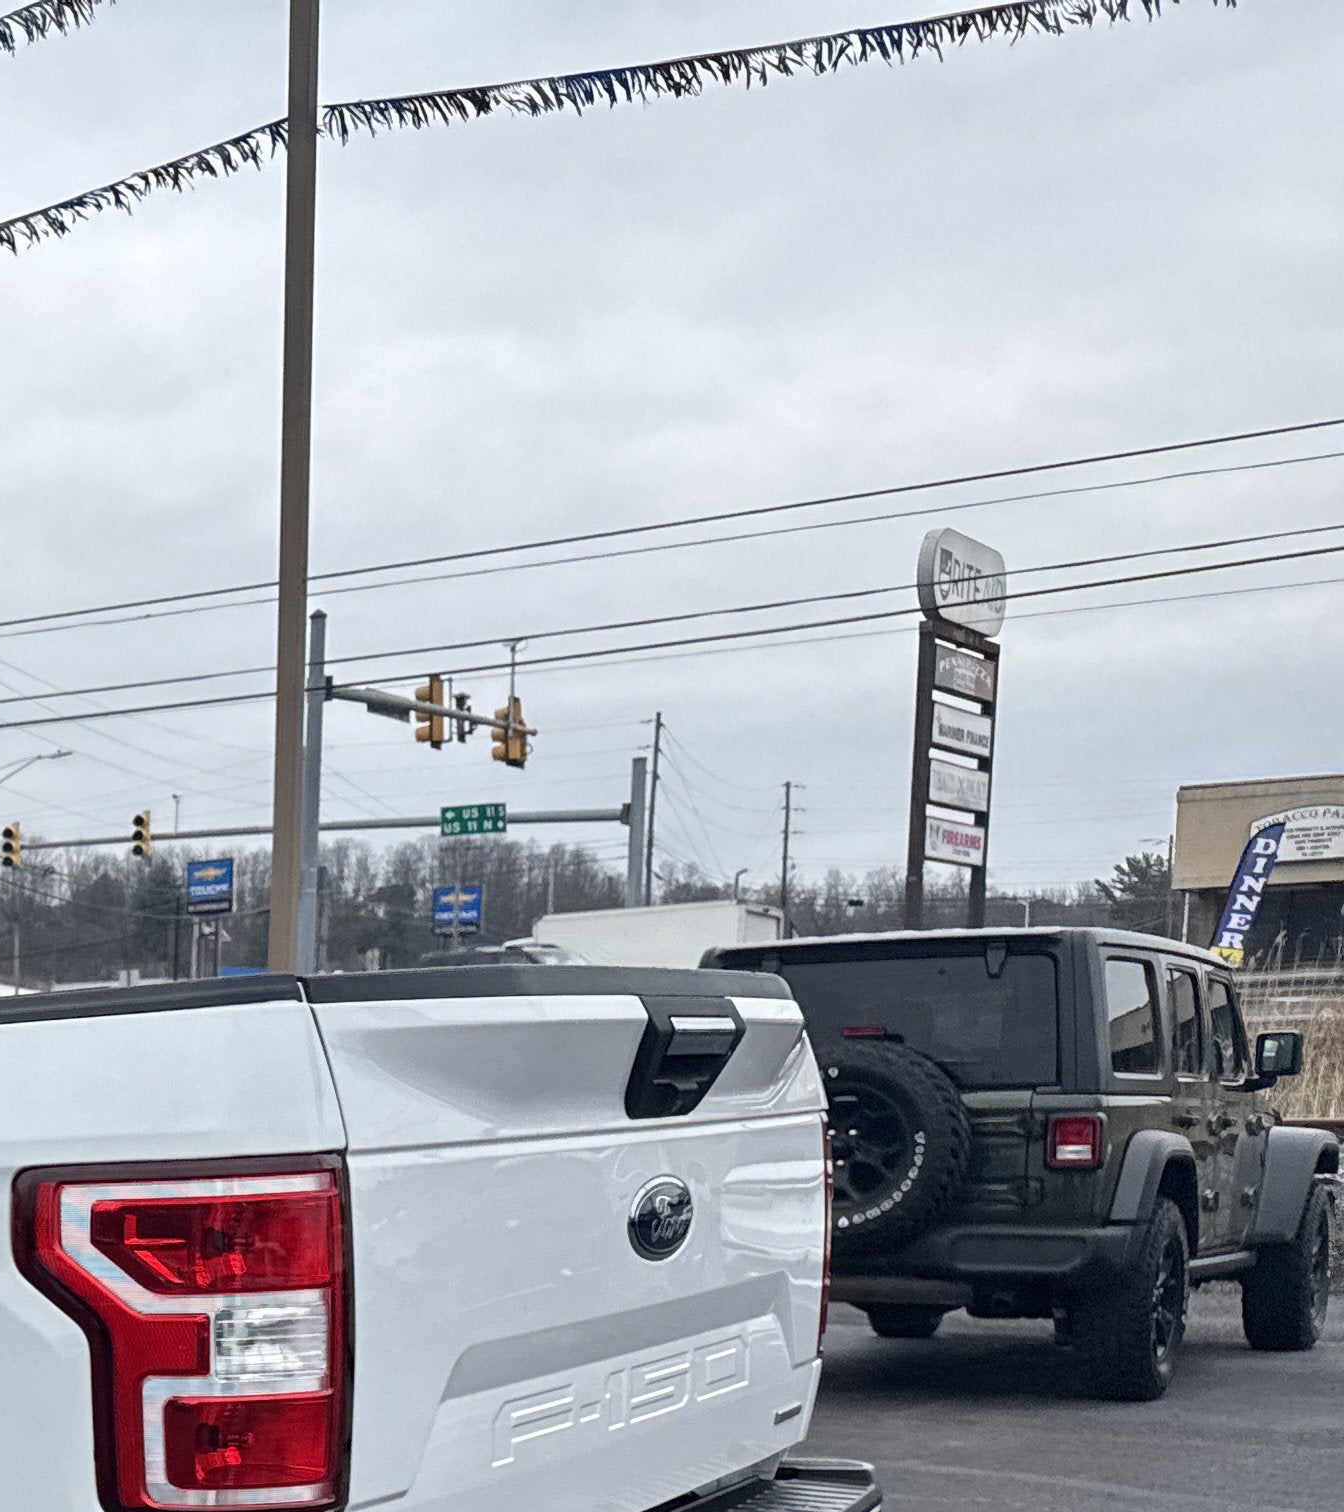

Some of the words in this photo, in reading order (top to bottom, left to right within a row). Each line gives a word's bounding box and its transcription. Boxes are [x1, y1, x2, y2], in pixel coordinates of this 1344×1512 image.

[443, 821, 461, 833] US
[467, 820, 478, 832] 11
[483, 819, 493, 830] N
[462, 808, 479, 820] US
[1218, 837, 1277, 950] DINNER
[491, 1334, 750, 1468] F-150
